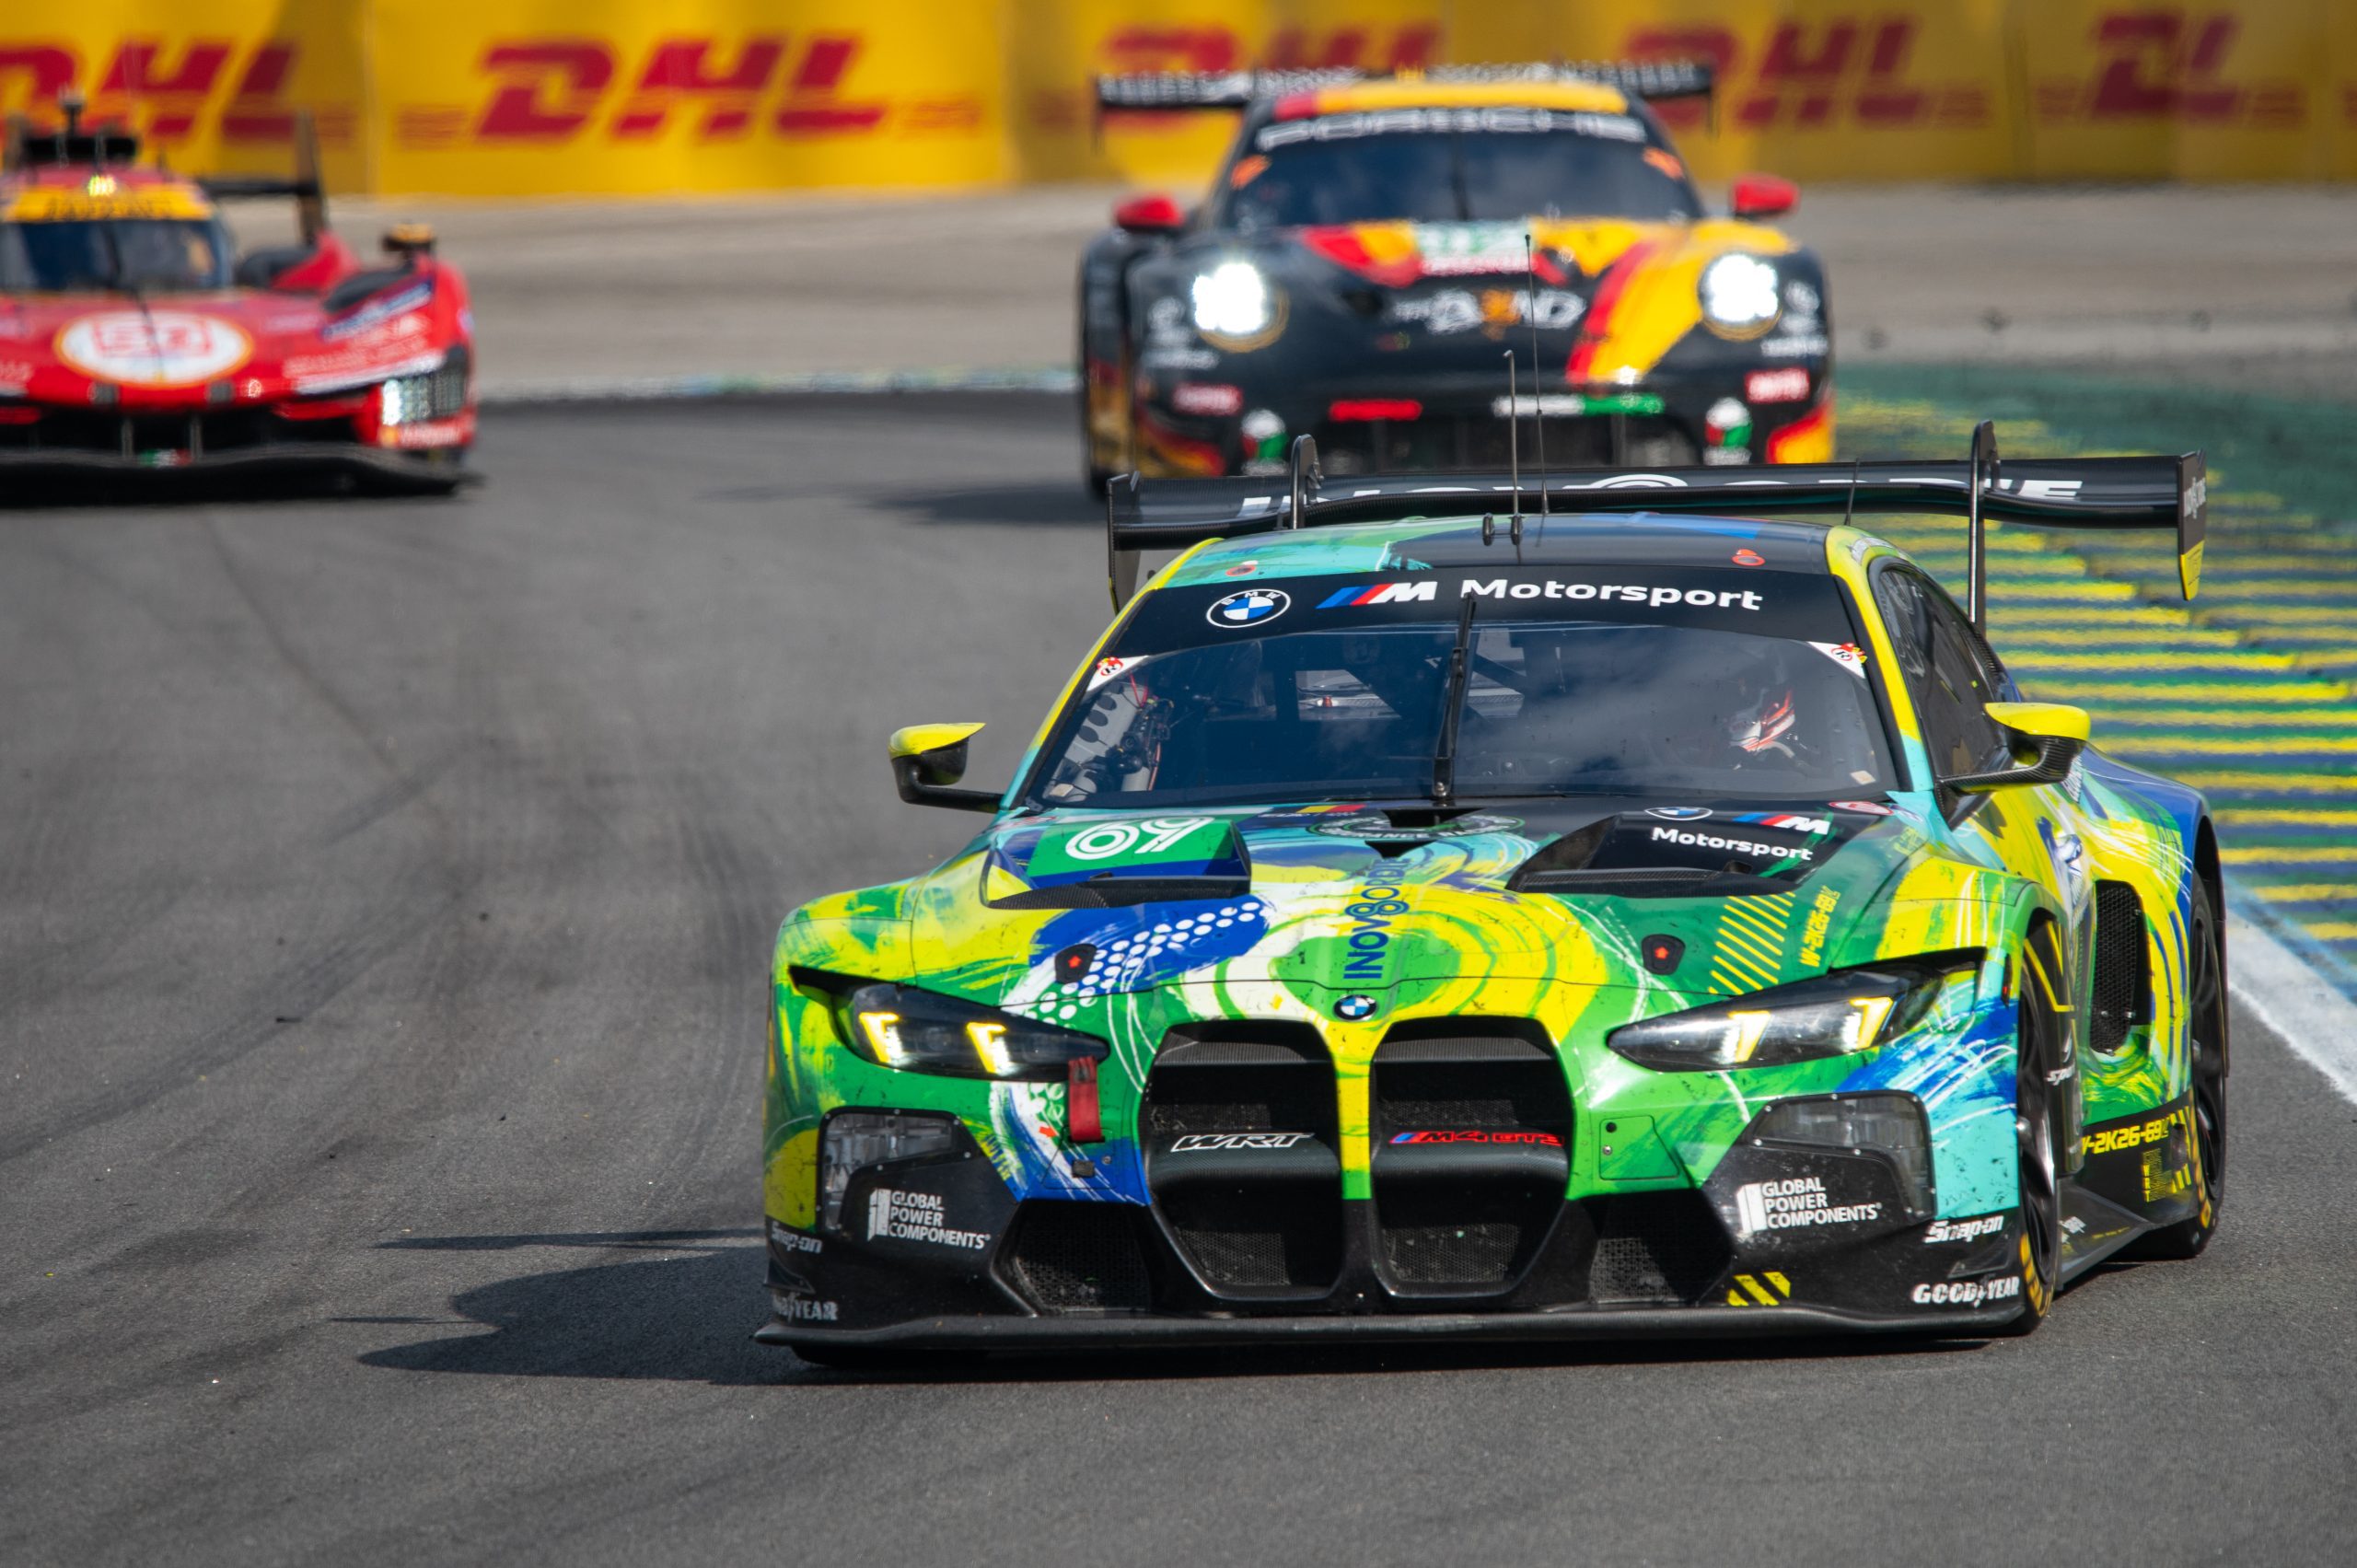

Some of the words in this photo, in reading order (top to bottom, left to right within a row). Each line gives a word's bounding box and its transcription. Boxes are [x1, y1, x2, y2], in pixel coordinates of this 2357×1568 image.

[476, 39, 888, 140] DHL
[1460, 578, 1763, 611] Motorsport
[1064, 817, 1214, 861] 69
[1651, 826, 1814, 862] Motorsport
[1171, 1132, 1315, 1153] WRT
[890, 1191, 946, 1212] GLOBAL
[1762, 1177, 1827, 1198] GLOBAL
[889, 1207, 945, 1227] POWER
[1765, 1192, 1829, 1214] POWER
[1923, 1214, 2004, 1243] Snap-on
[1911, 1275, 2020, 1307] GOODYEAR
